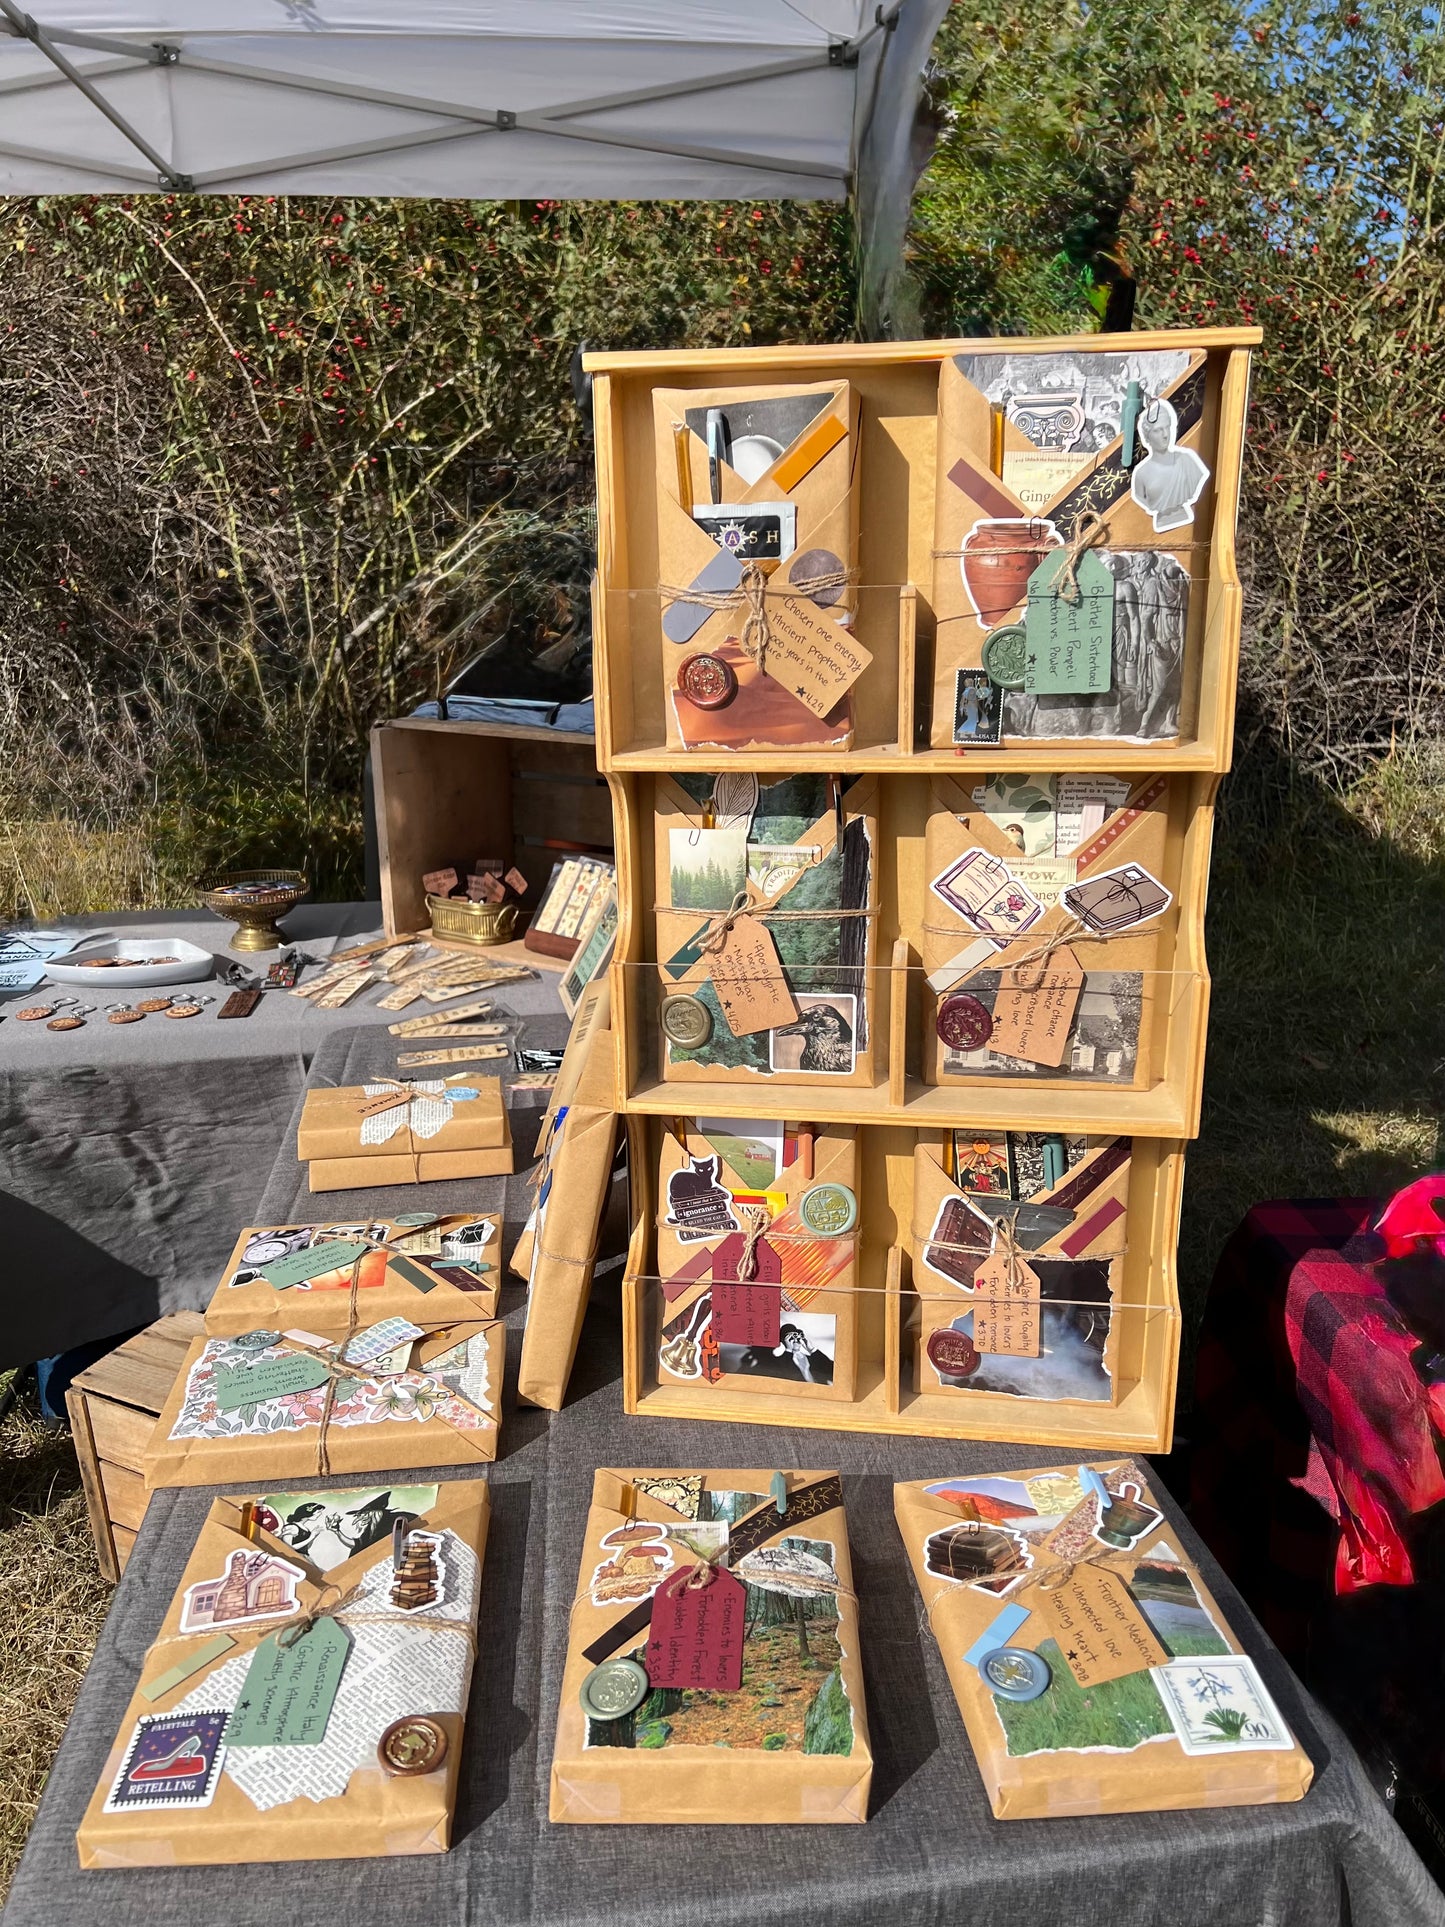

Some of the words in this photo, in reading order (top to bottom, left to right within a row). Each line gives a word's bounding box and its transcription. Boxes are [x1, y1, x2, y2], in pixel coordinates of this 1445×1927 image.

[1089, 585, 1104, 630] Brothel
[772, 612, 807, 645] Ancient
[807, 645, 847, 683] prophecy
[784, 597, 814, 629] Chosen
[816, 626, 832, 642] one
[833, 641, 861, 672] energy
[784, 648, 805, 666] years
[805, 663, 814, 674] in
[815, 671, 828, 686] the
[1049, 646, 1061, 677] Power
[1088, 635, 1103, 688] Sisterhood
[1044, 974, 1059, 1009] romance
[1012, 1010, 1021, 1026] love
[1046, 1009, 1062, 1037] chance
[1018, 1028, 1032, 1054] lovers
[683, 1204, 717, 1217] ignorance
[990, 1321, 998, 1353] romance
[1003, 1325, 1013, 1349] lovers
[1017, 1320, 1034, 1353] Royalty
[696, 1594, 713, 1645] Forbidden
[722, 1597, 736, 1636] Enemies
[1049, 1591, 1074, 1630] Healing
[1072, 1630, 1099, 1662] heart
[1072, 1585, 1109, 1633] Unexpected
[1103, 1638, 1122, 1659] love
[1098, 1582, 1129, 1622] Frontier
[1124, 1623, 1157, 1666] Medicine
[660, 1635, 687, 1682] Identity
[721, 1640, 734, 1649] to
[289, 1645, 313, 1682] Gothic
[306, 1645, 337, 1710] Renaissance
[690, 1650, 708, 1682] Forest
[716, 1655, 734, 1682] lovers
[151, 1719, 197, 1733] FAIRYTALE
[289, 1715, 320, 1741] Italy
[1244, 1723, 1270, 1740] 90
[128, 1780, 197, 1796] RETELLING
